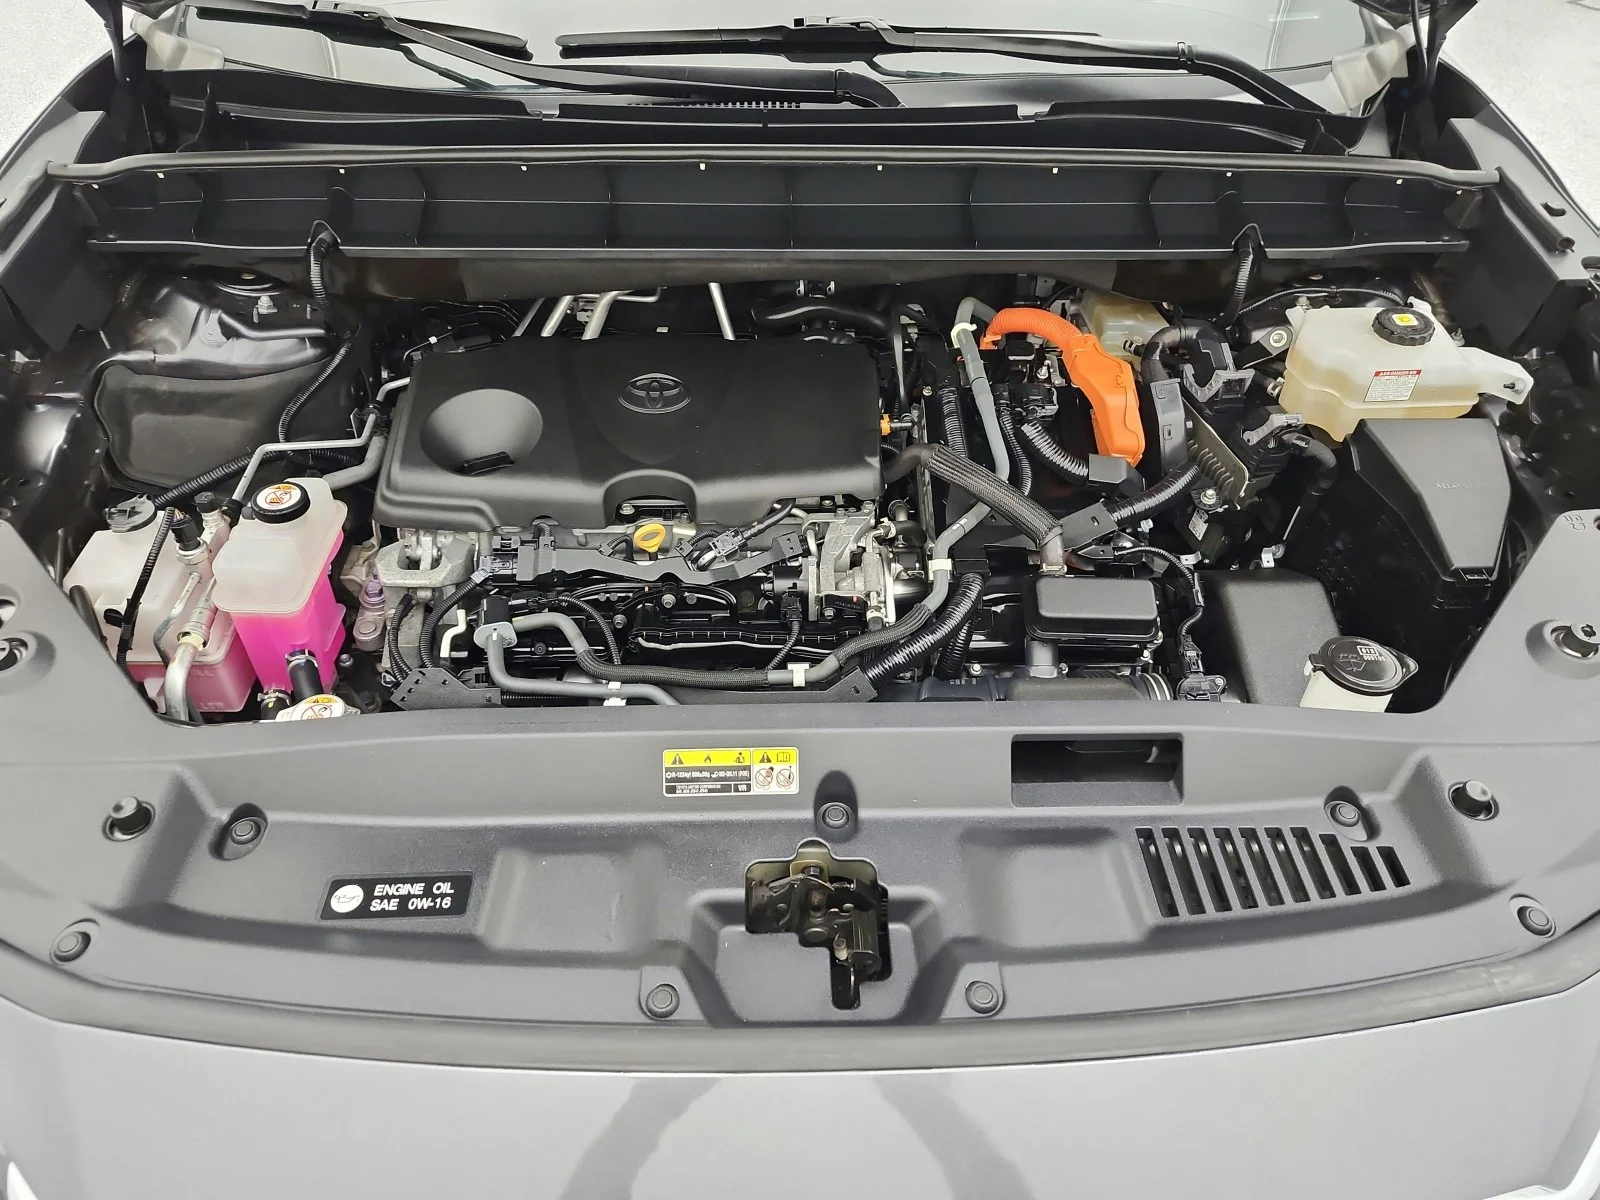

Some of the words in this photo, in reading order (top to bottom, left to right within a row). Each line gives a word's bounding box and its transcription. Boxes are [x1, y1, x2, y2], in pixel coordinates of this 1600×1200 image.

[374, 883, 425, 896] ENGINE
[432, 882, 455, 894] OIL
[370, 899, 399, 911] SAE
[408, 897, 451, 910] 0W-16
